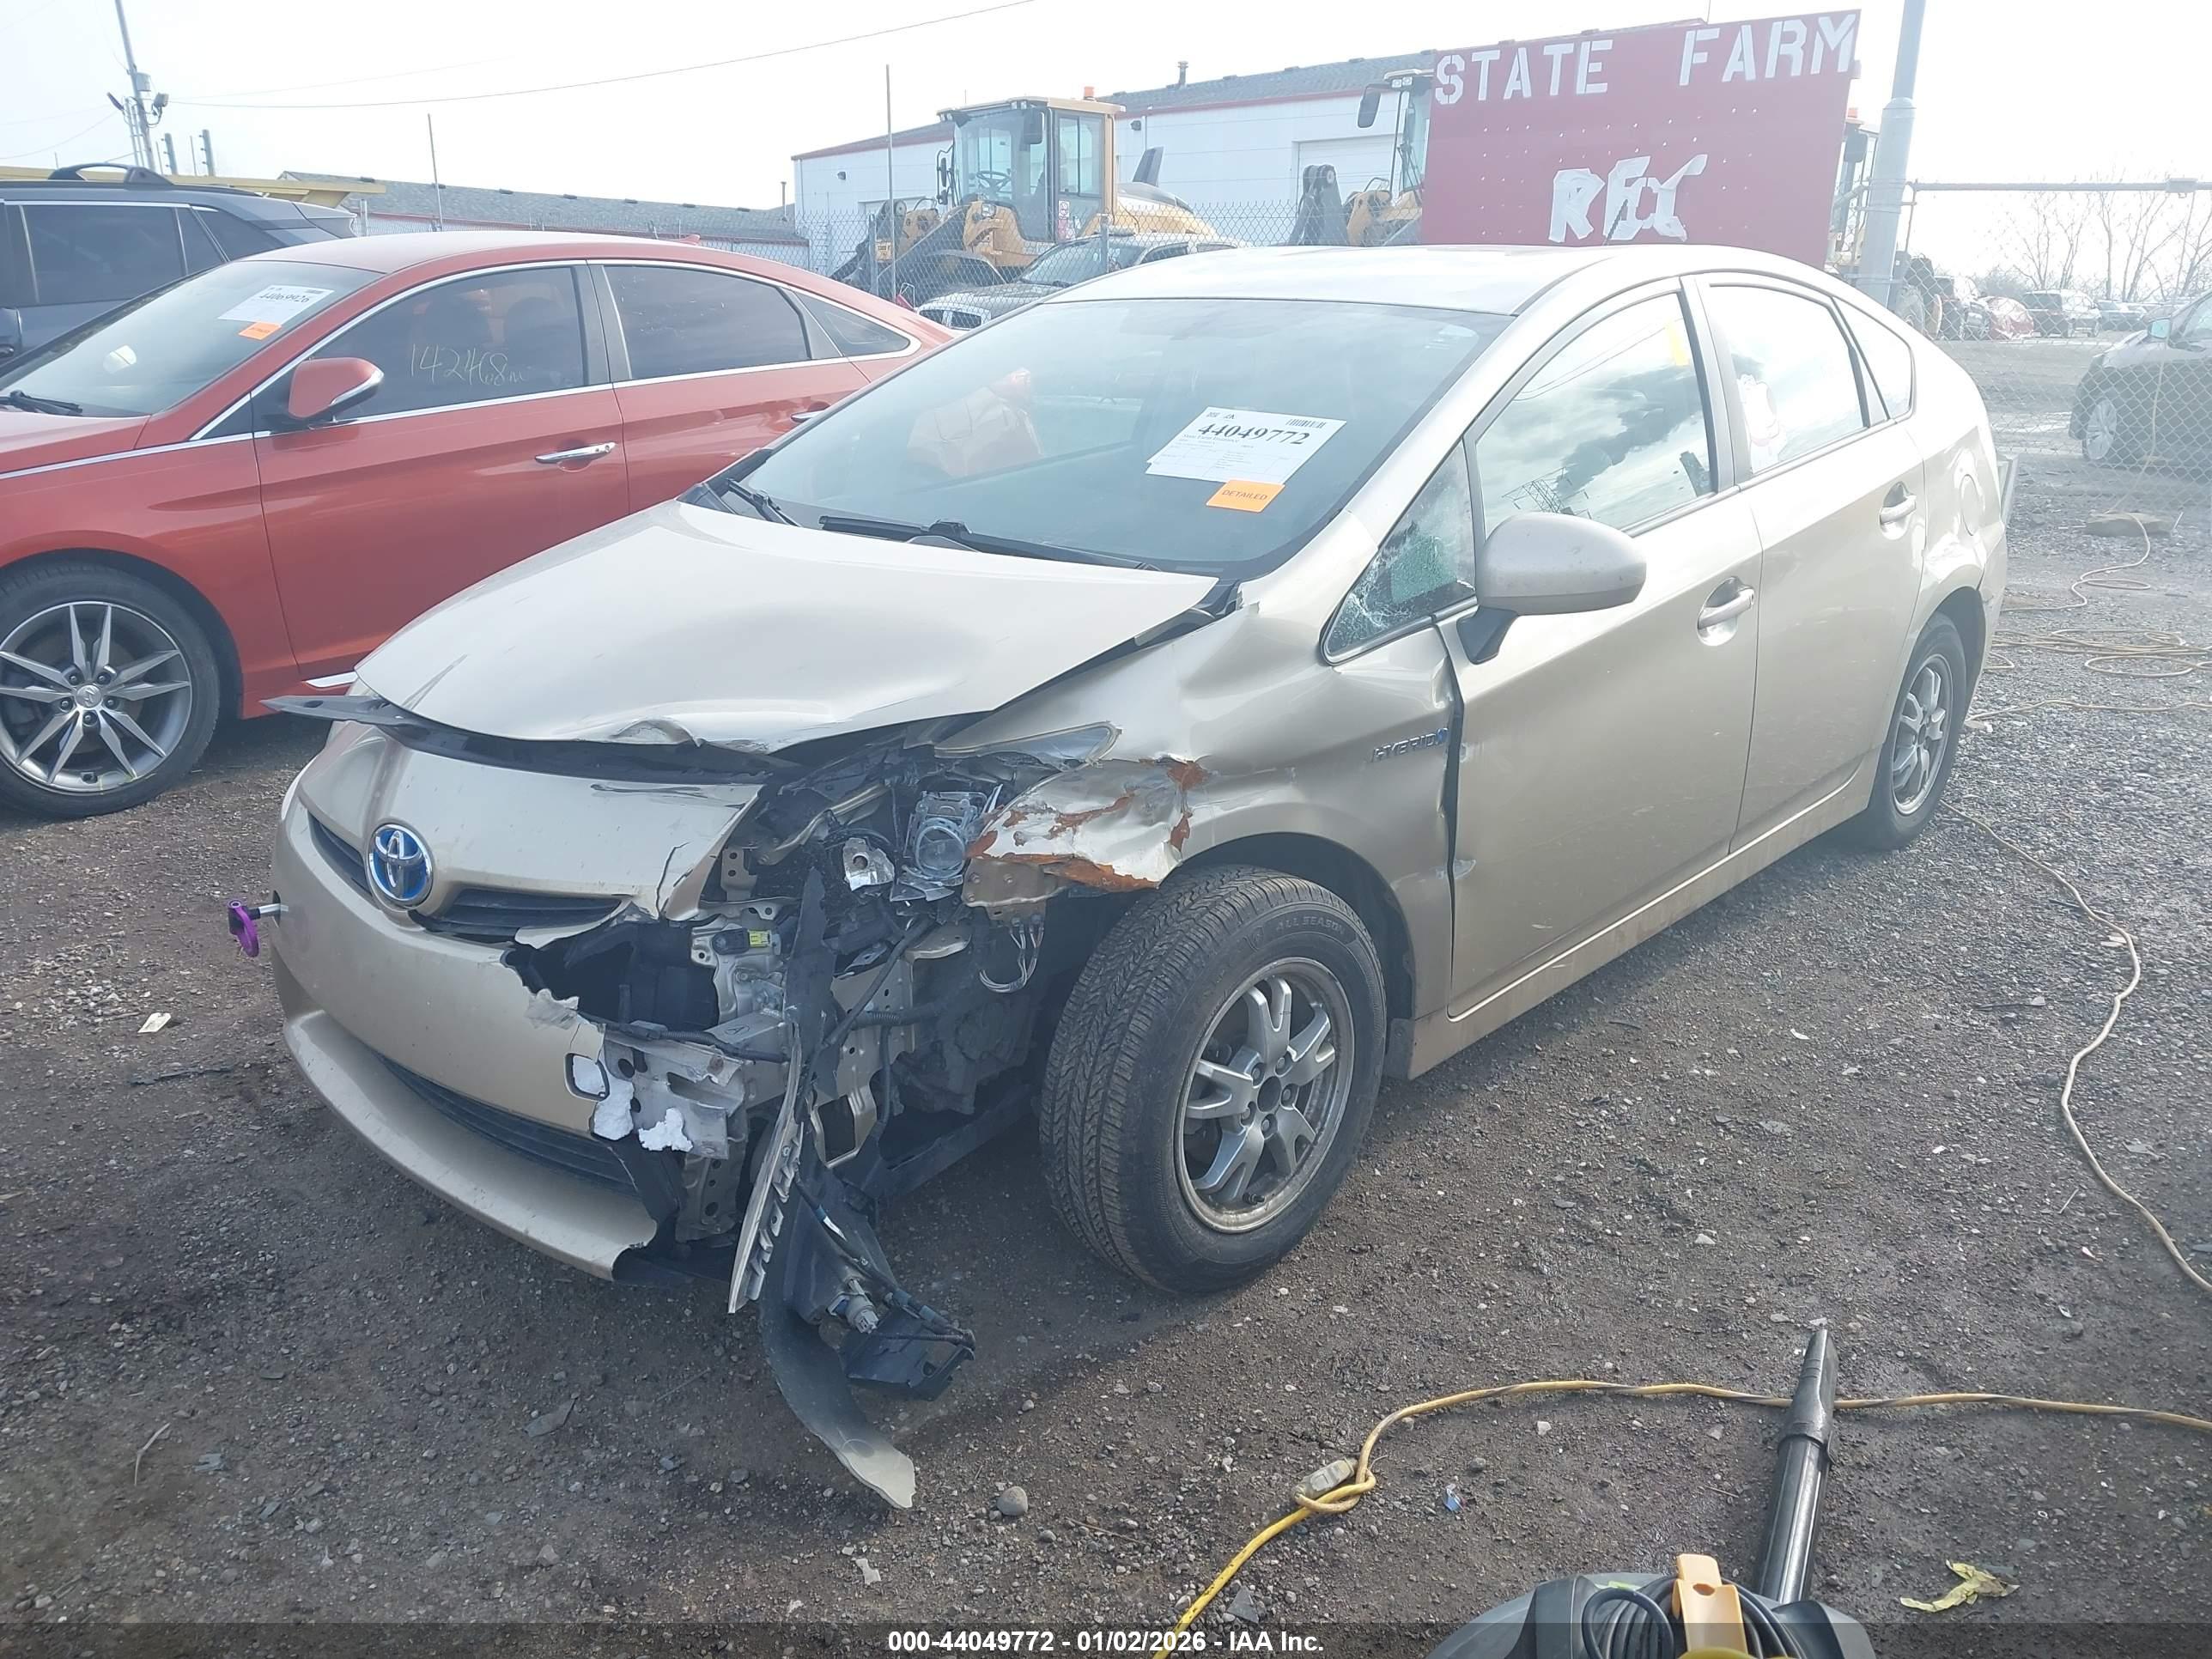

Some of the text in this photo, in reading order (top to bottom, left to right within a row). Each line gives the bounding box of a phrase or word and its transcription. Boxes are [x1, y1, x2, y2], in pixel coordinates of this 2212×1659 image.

[1435, 13, 1857, 105] STATE FARM
[1198, 423, 1310, 445] 44049772
[1222, 489, 1267, 501] DETAILED
